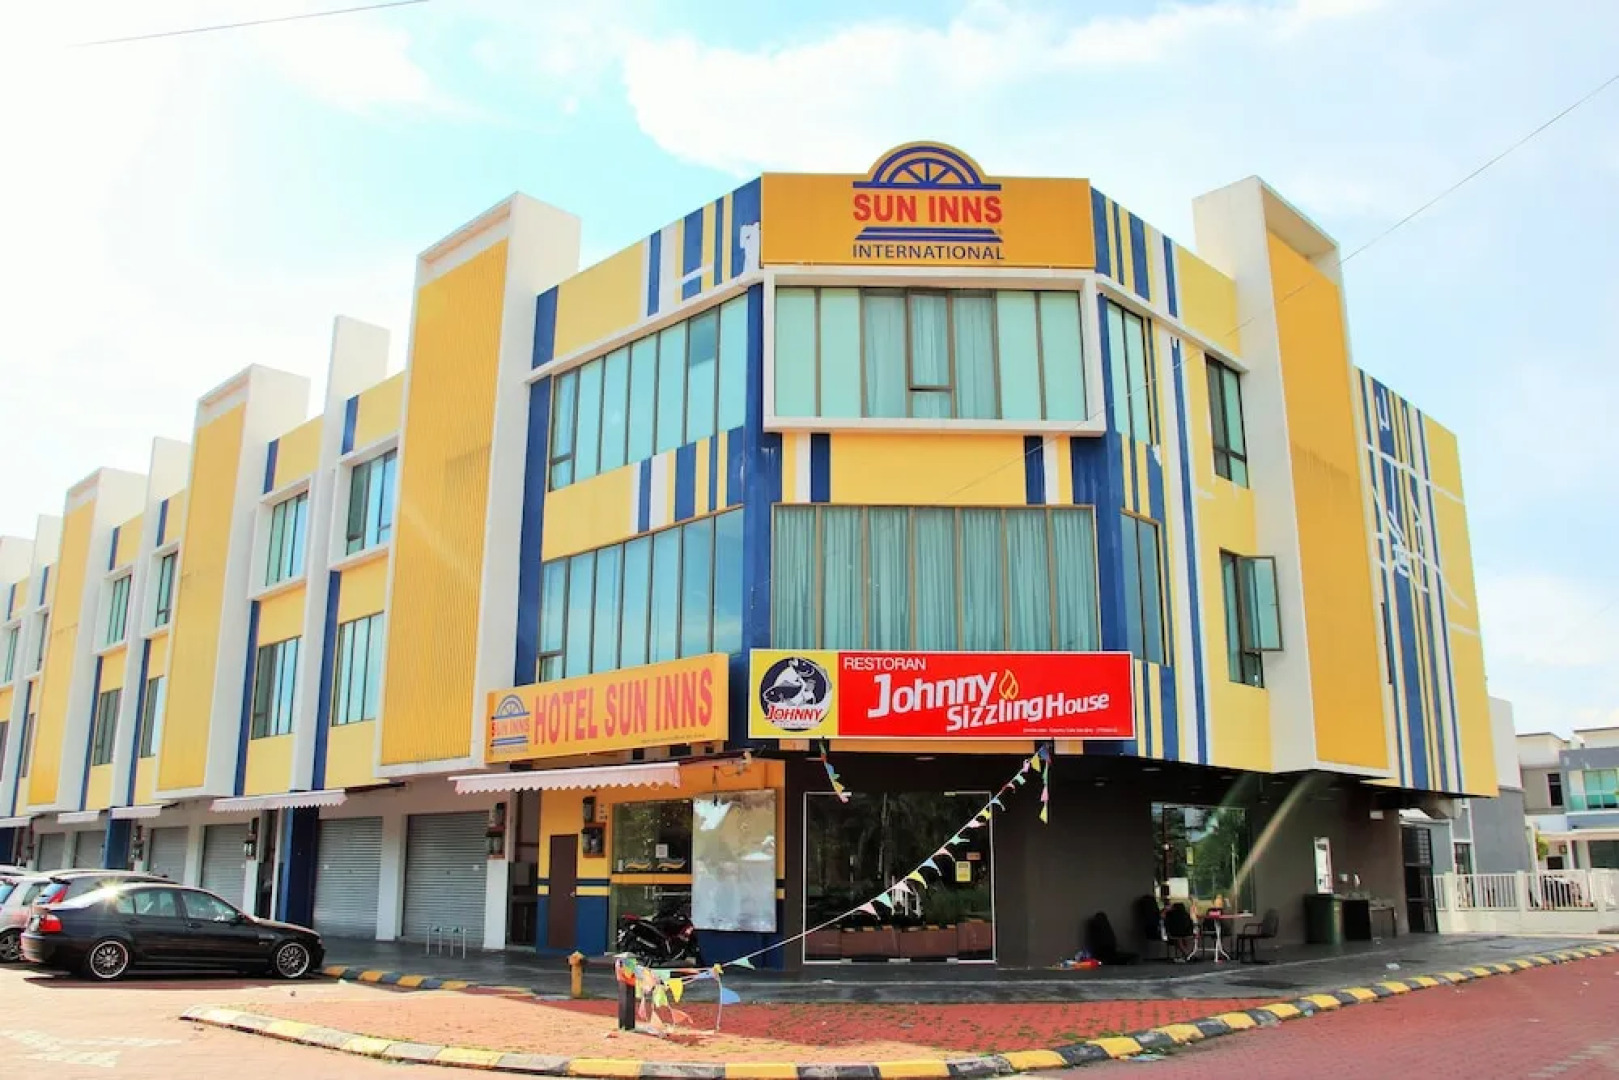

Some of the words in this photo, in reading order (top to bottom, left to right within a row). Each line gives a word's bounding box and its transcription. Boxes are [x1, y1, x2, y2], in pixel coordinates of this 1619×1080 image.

[853, 194, 916, 222] SUN
[928, 195, 1003, 224] INNS
[853, 244, 1005, 260] INTERNATIONAL
[844, 657, 927, 671] RESTORAN
[533, 687, 598, 745] HOTEL
[604, 677, 648, 738] SUN
[655, 667, 713, 732] INNS
[867, 672, 998, 719] Johnny
[764, 705, 823, 720] JOHNNY
[946, 696, 1044, 732] Sizzling
[1046, 692, 1110, 718] House
